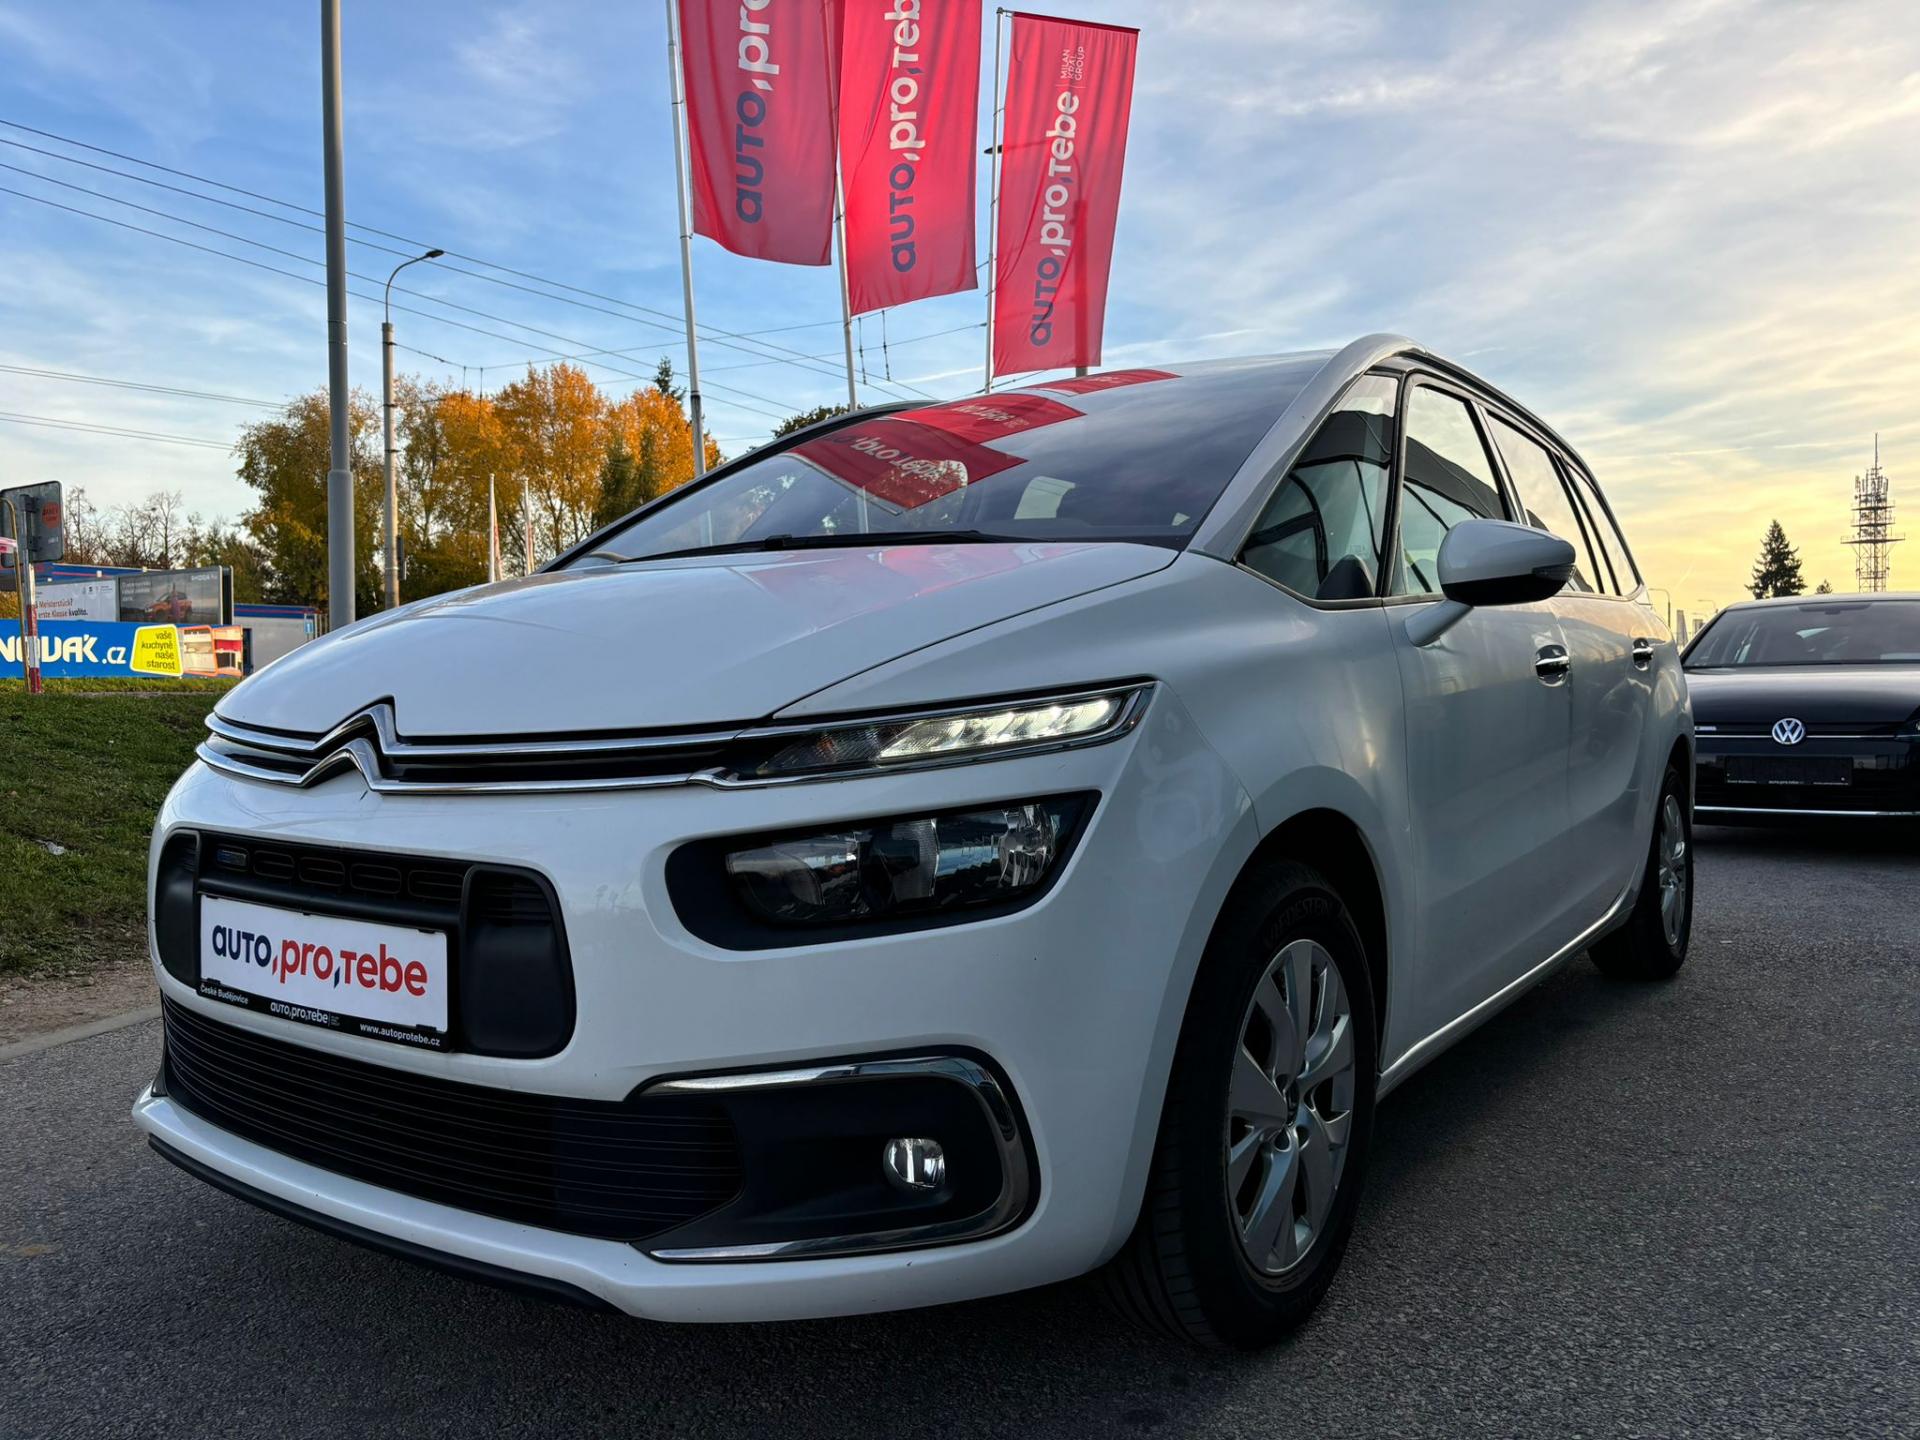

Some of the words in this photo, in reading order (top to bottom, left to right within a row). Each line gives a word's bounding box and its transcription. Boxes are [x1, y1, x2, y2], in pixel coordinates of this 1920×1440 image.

[1060, 49, 1070, 79] MILAN
[1074, 46, 1085, 81] GROUP
[155, 630, 172, 640] vaše
[141, 641, 174, 651] kuchyně
[155, 650, 174, 660] naše
[146, 659, 176, 670] starost
[359, 1023, 441, 1047] www.autoprotebe.cz
